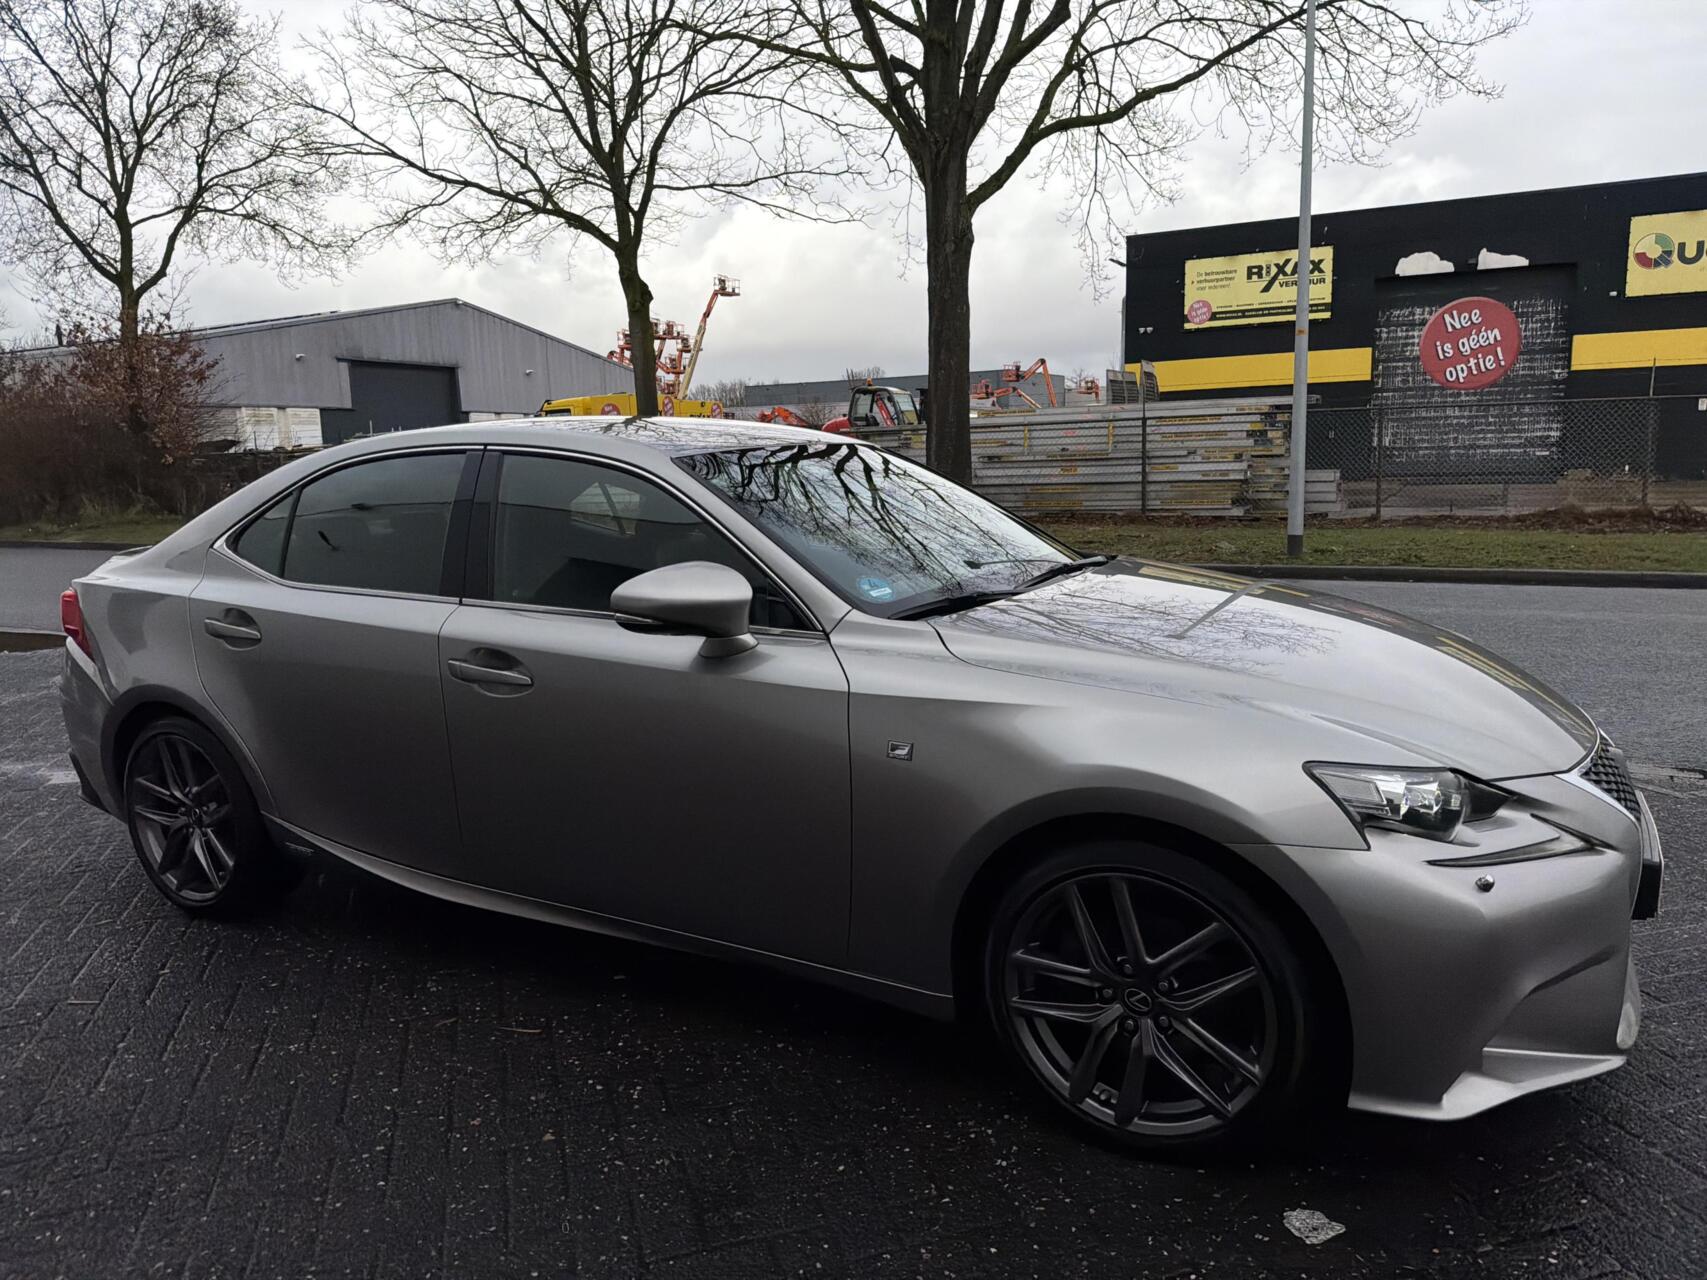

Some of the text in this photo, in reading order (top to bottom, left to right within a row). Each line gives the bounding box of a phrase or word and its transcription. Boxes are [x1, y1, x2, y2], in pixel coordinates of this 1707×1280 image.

[1278, 278, 1326, 288] VERUR
[1444, 308, 1482, 332] Nee
[1436, 326, 1501, 360] is géén
